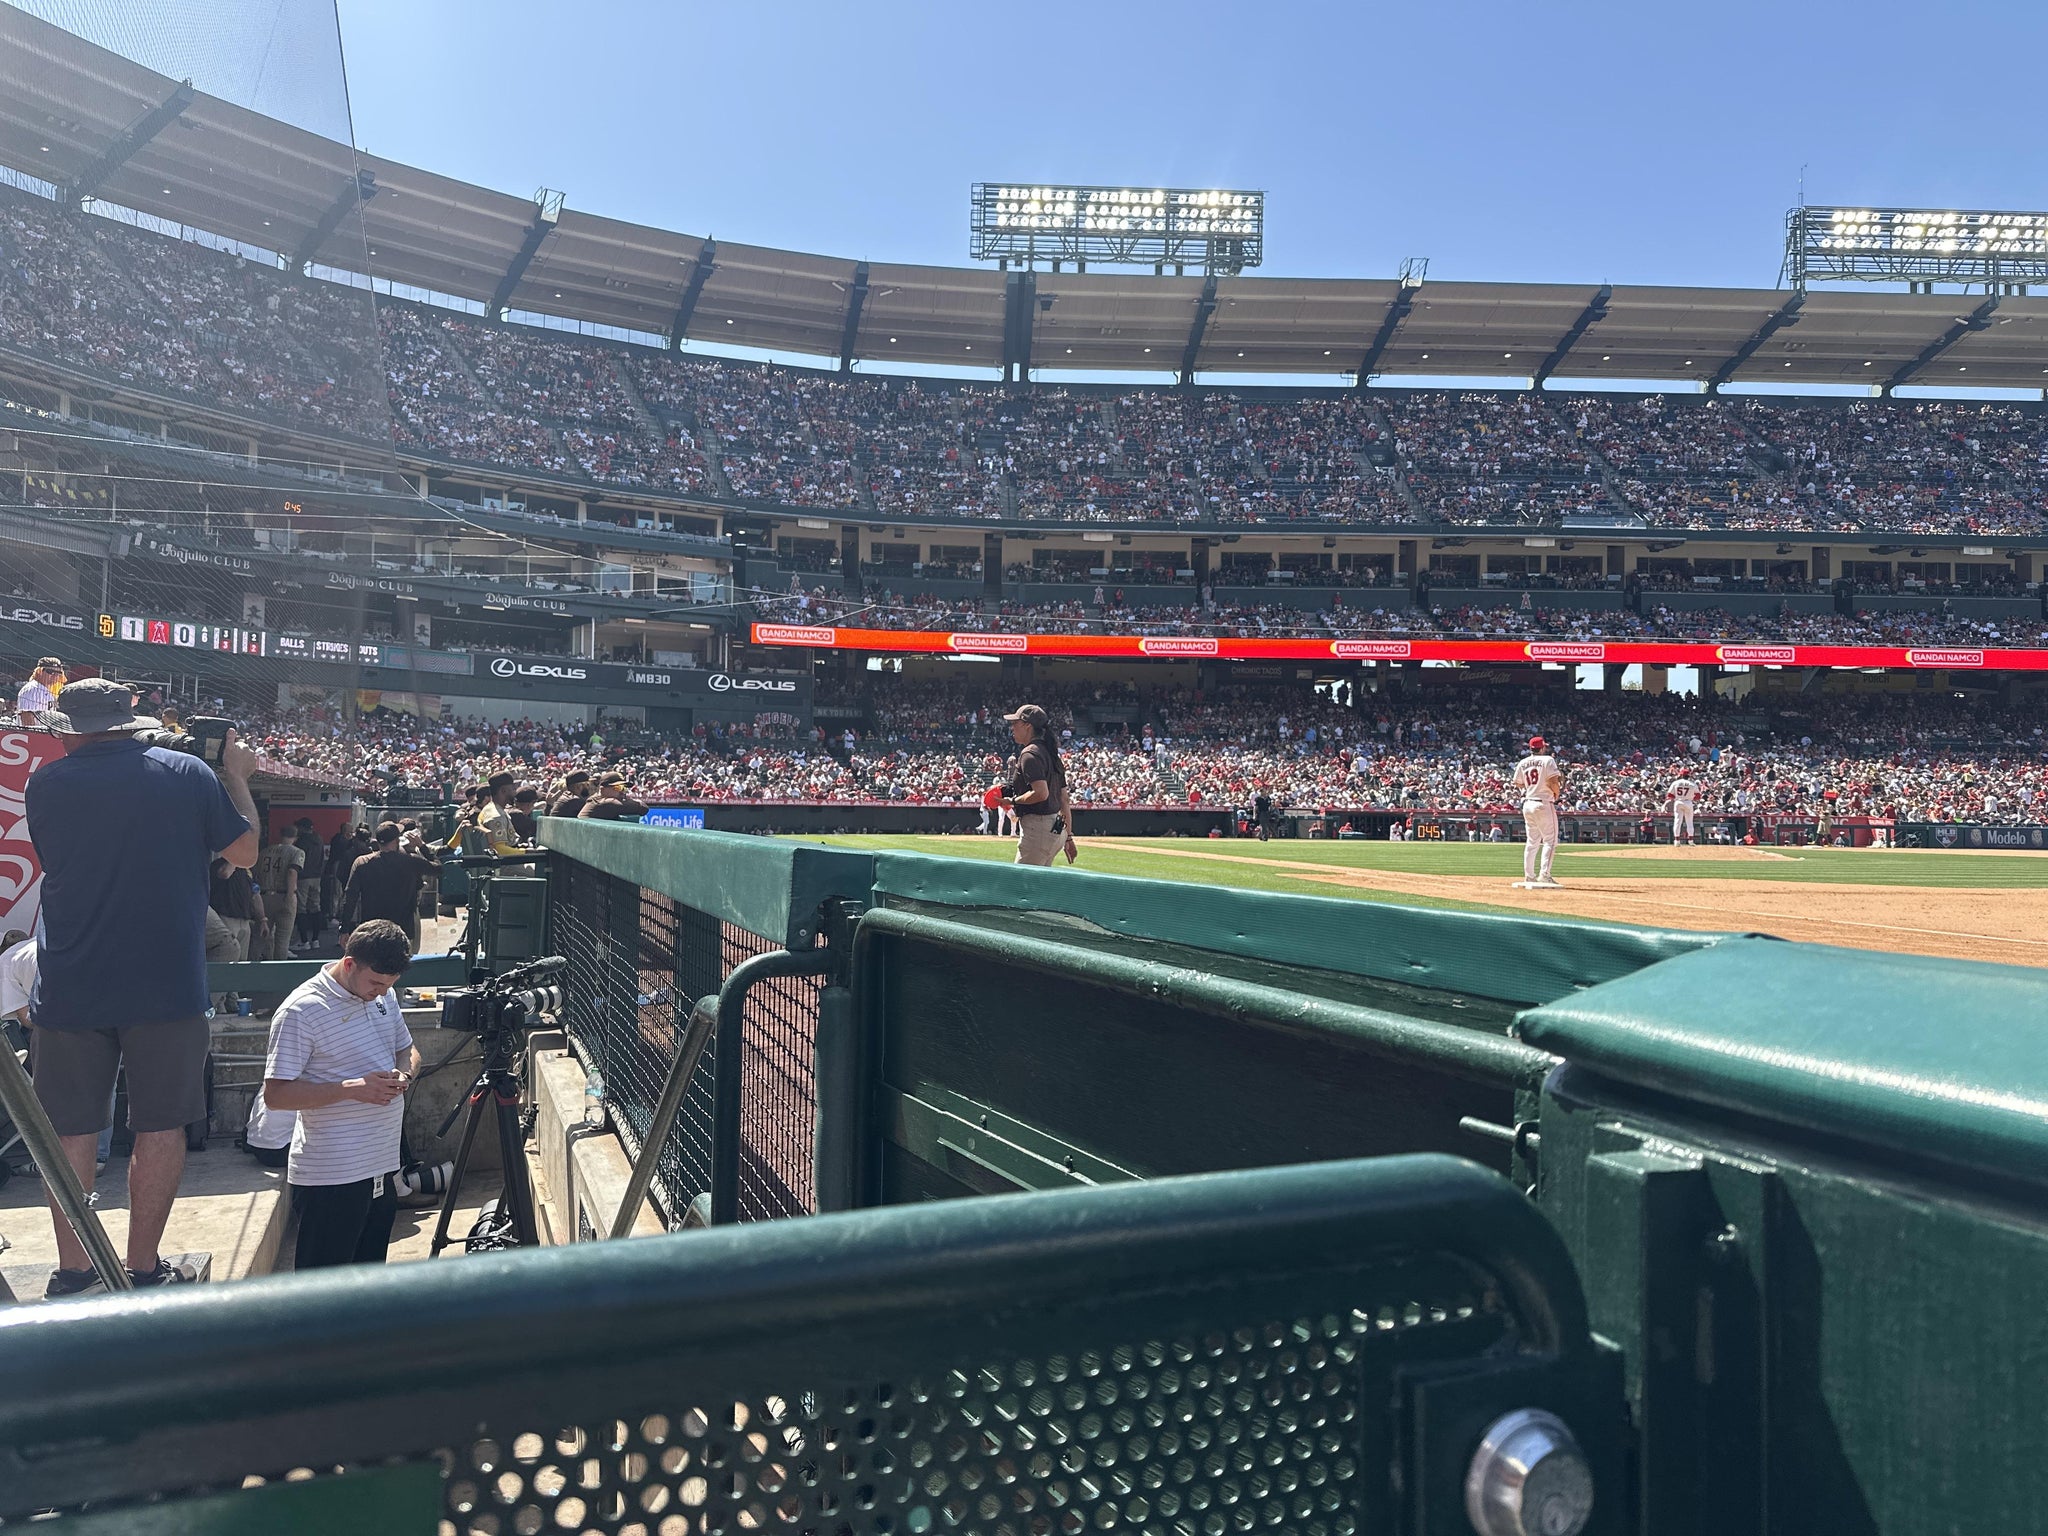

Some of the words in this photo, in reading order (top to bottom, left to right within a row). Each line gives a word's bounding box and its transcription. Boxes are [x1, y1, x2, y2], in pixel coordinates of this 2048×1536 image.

[214, 556, 250, 569] CLUB
[379, 580, 413, 593] CLUB
[533, 600, 566, 610] CLUB
[0, 606, 83, 630] LEXUS
[129, 620, 136, 638] 1
[179, 626, 189, 643] 0
[201, 632, 208, 643] 6
[223, 630, 229, 638] 3
[251, 634, 257, 642] 2
[761, 629, 796, 638] BANDAI
[797, 631, 830, 640] NAMCO
[222, 641, 229, 649] 3
[250, 645, 256, 653] 2
[280, 637, 305, 649] BALLS
[316, 641, 349, 653] STRIKES
[956, 637, 989, 646] BANDAI
[990, 638, 1023, 647] NAMCO
[1147, 642, 1180, 650] BANDAI
[1181, 643, 1213, 651] NAMCO
[1339, 644, 1371, 652] BANDAI
[1373, 645, 1406, 653] NAMCO
[1532, 646, 1566, 654] BANDAI
[1567, 647, 1600, 655] NAMCO
[1724, 650, 1757, 658] BANDAI
[1914, 653, 1946, 661] BANDAI
[1947, 654, 1979, 662] NAMCO
[517, 664, 587, 680] LEXUS
[626, 669, 671, 685] AM830
[1261, 666, 1282, 676] TACOS
[1459, 670, 1494, 682] Classic
[732, 678, 796, 692] LEXUS
[1863, 674, 1890, 684] PORCH
[1525, 768, 1538, 786] 18
[1677, 787, 1690, 797] 57
[650, 815, 682, 827] Globe
[683, 815, 703, 829] Life
[1987, 830, 2026, 845] Modelo
[264, 856, 281, 872] 34
